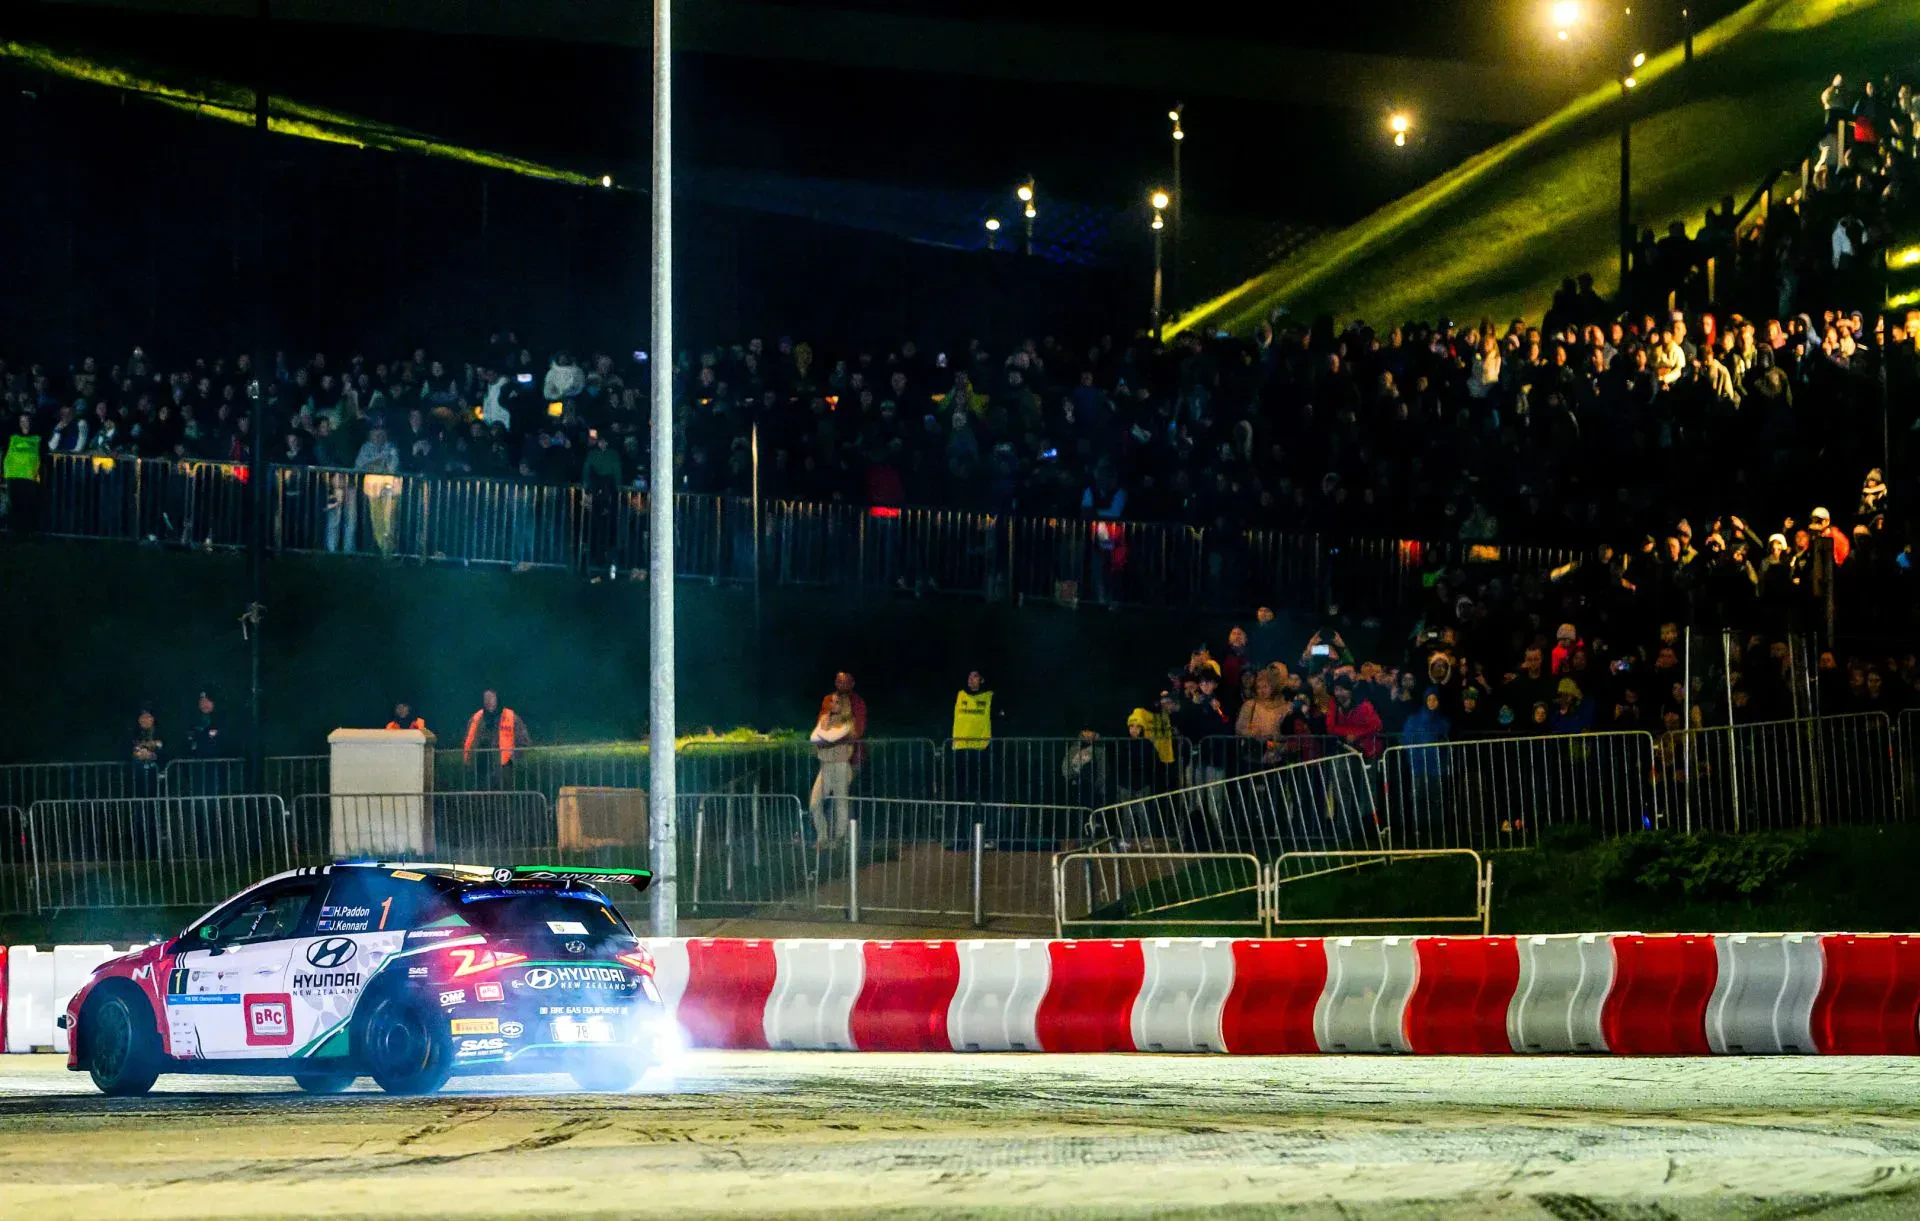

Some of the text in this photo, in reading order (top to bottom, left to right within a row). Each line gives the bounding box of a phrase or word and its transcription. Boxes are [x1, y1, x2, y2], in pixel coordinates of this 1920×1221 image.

[561, 873, 635, 883] HYUNDAI
[333, 906, 370, 917] H.Paddon
[379, 896, 393, 930] 1
[329, 920, 369, 931] J.Kennard
[408, 967, 428, 975] SAS
[557, 967, 626, 983] HYUNDAI
[175, 970, 183, 994] 1
[293, 973, 360, 988] HYUNDAI
[561, 982, 626, 991] NEW ZEALAND
[317, 988, 359, 996] ZEALAND
[440, 991, 466, 1004] OMP
[255, 1009, 282, 1025] BRC
[460, 1038, 505, 1051] SAS
